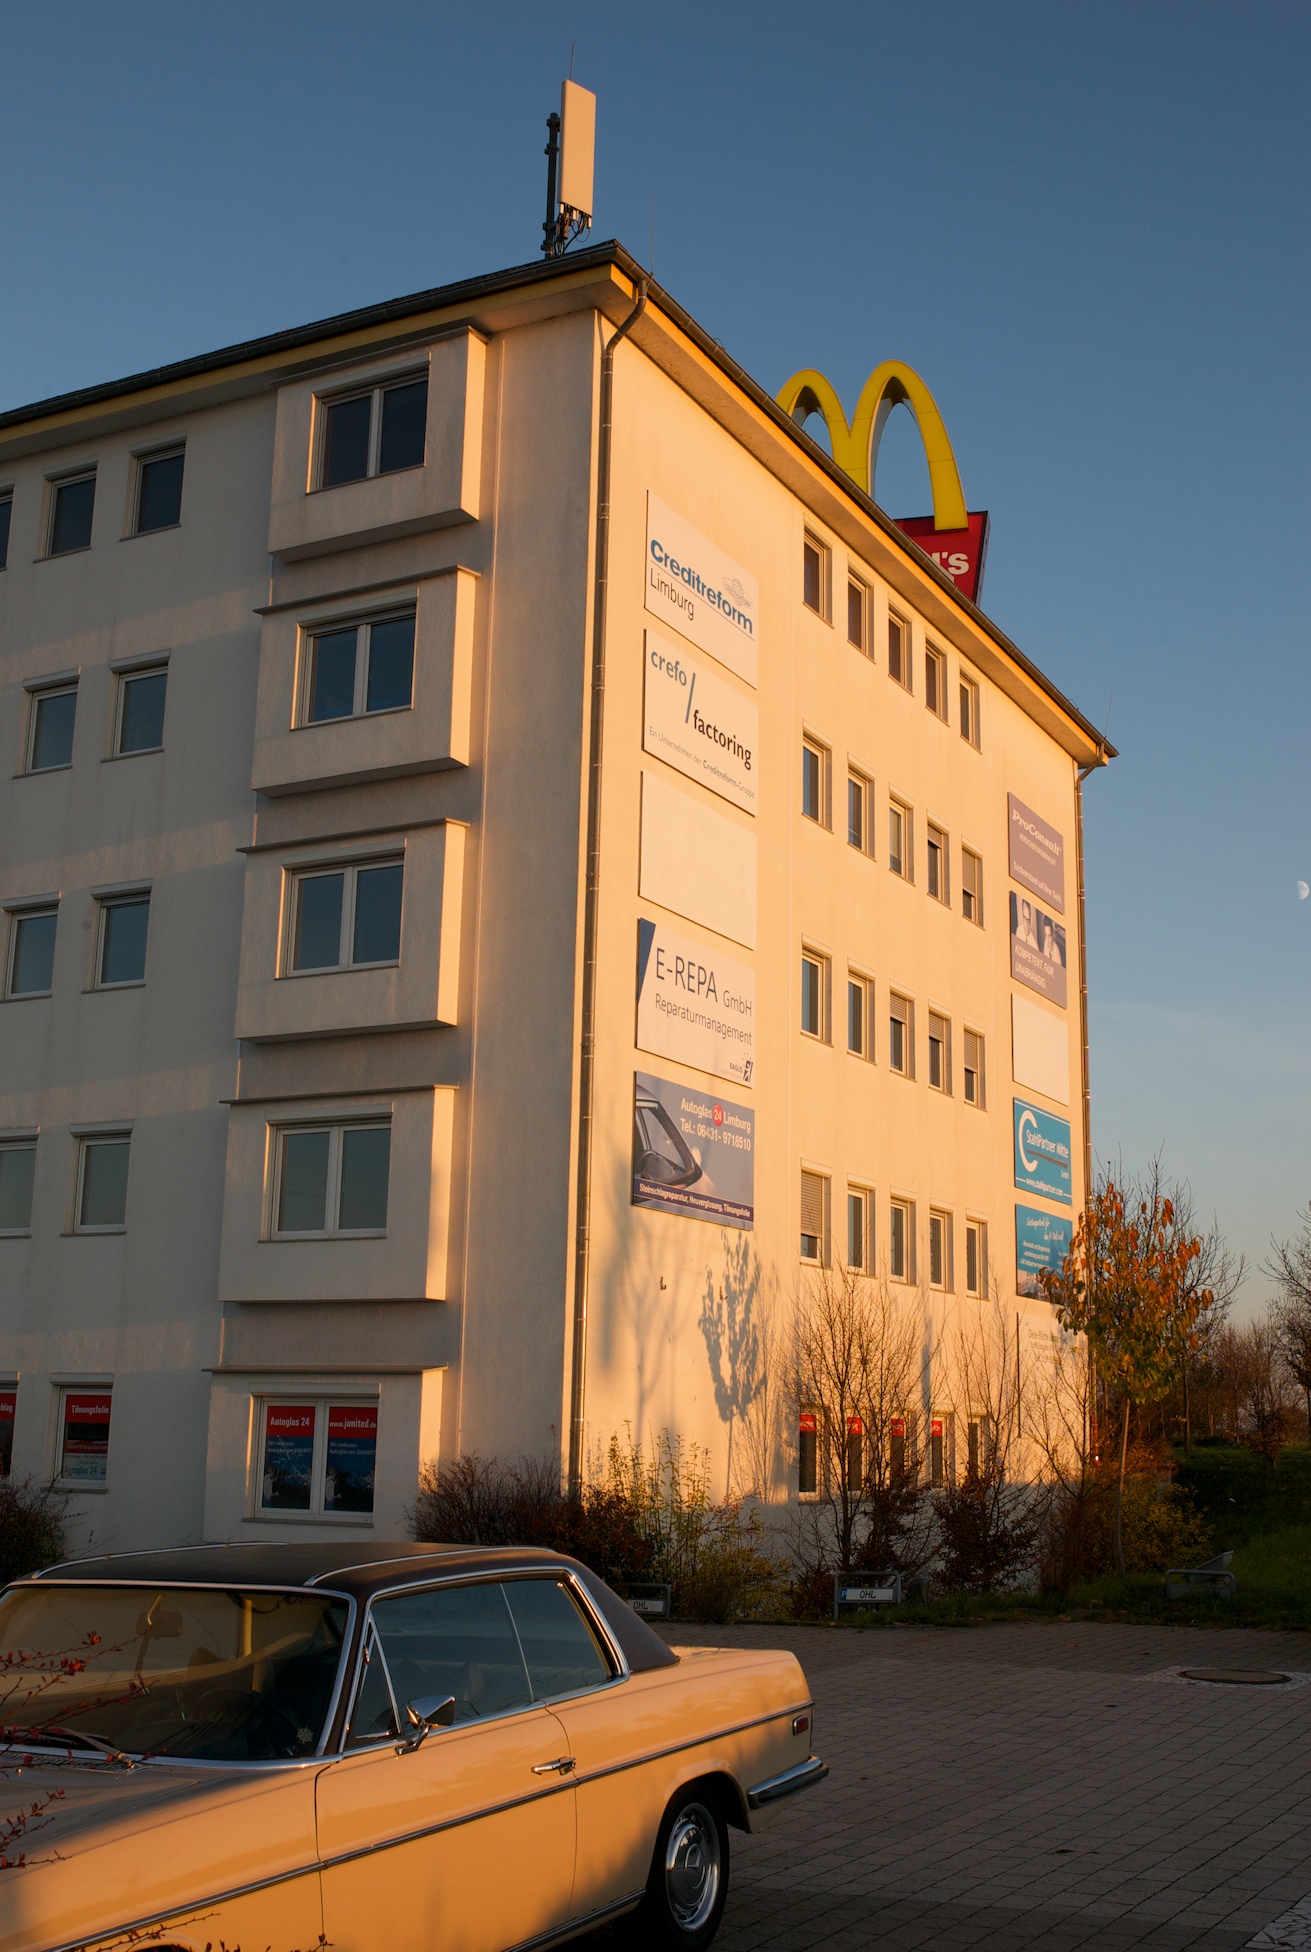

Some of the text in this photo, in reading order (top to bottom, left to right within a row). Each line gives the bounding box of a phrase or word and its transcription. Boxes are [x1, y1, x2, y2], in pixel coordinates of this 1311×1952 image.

[650, 539, 753, 634] Creditreform
[650, 567, 695, 621] Limburg
[650, 651, 687, 687] crefo
[649, 725, 658, 739] Ein
[658, 731, 693, 760] Unternehmen
[693, 752, 702, 766] der
[693, 709, 752, 771] factoring
[1011, 808, 1061, 856] ProConsult
[656, 946, 752, 1017] E-REPA GmbH
[655, 992, 752, 1046] Reparaturmanagement
[729, 1062, 743, 1074] BAGUS
[680, 1098, 751, 1134] Autoglas 24 Limburg
[680, 1118, 696, 1134] Tel.:
[723, 1131, 752, 1152] 9718510
[639, 1182, 689, 1203] Steinschlagreparatur,
[71, 1404, 110, 1415] Tönungsfolie
[270, 1417, 310, 1428] Autoglas 24
[329, 1418, 377, 1429] www.junited.de
[90, 1466, 97, 1475] 24
[633, 1600, 649, 1610] OHL
[859, 1590, 876, 1599] OHL
